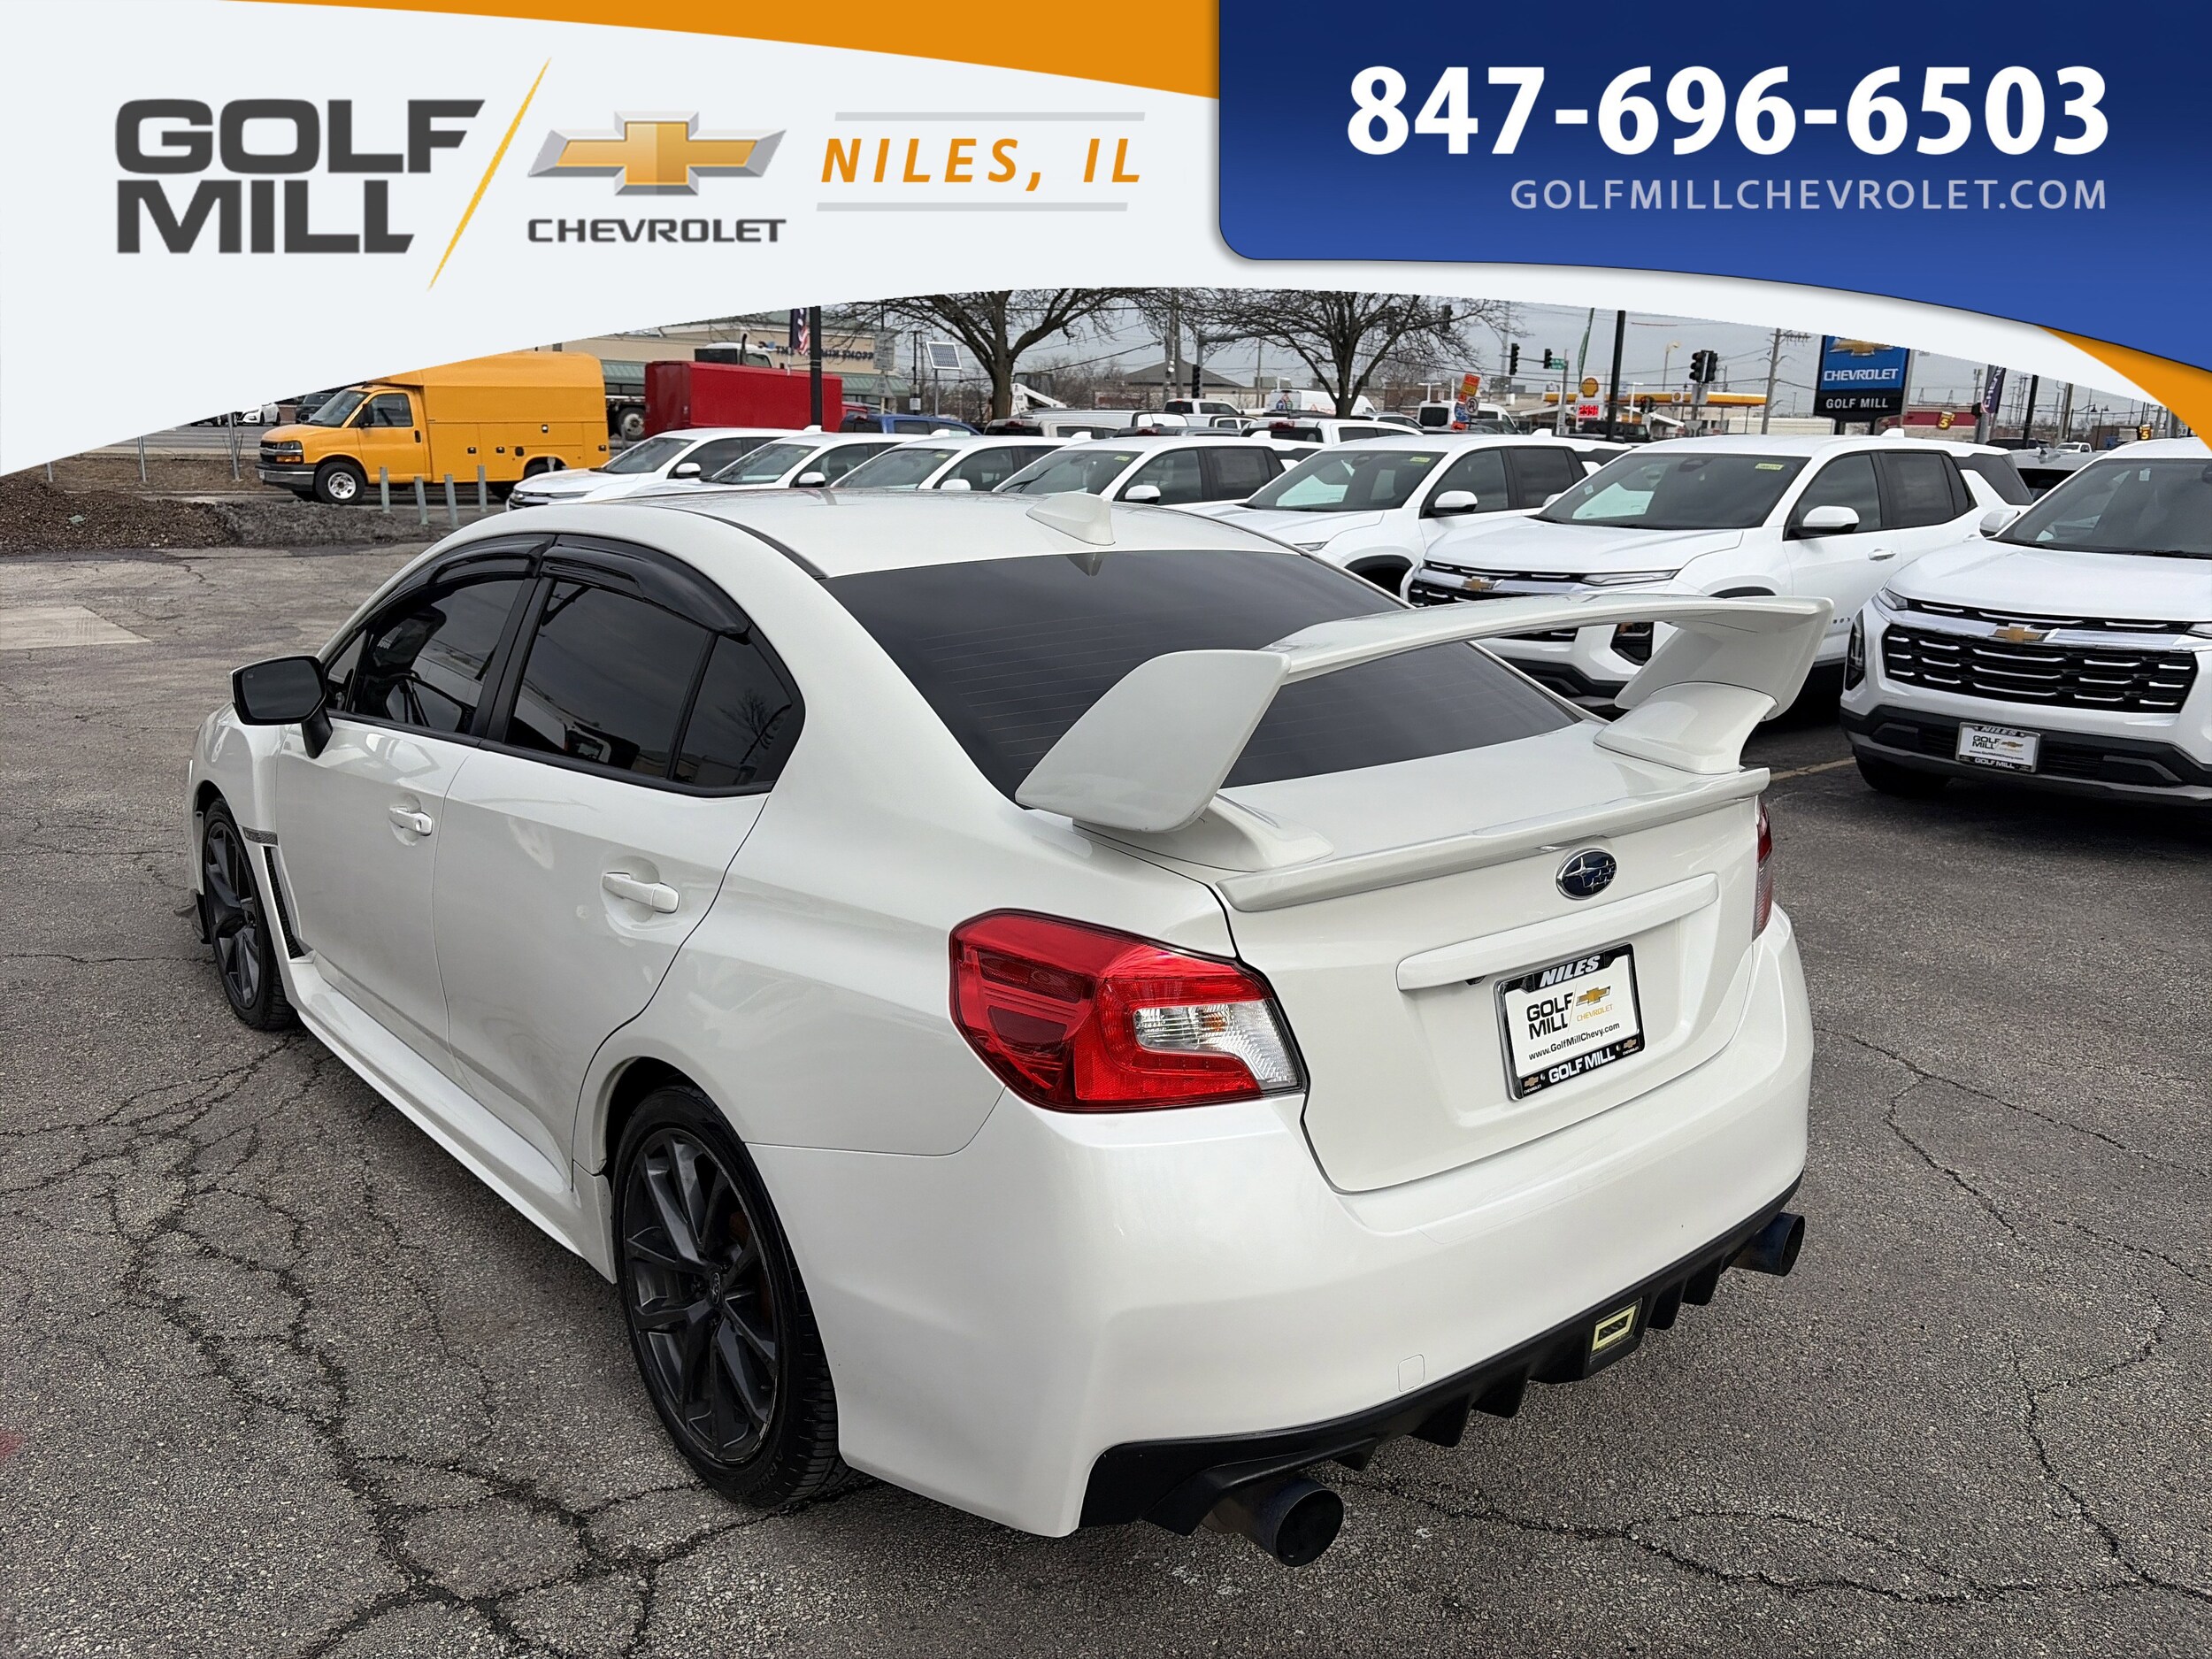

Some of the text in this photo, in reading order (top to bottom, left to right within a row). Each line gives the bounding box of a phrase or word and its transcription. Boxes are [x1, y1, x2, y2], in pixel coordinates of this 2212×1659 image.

[1824, 368, 1900, 381] CHEVROLET
[1825, 397, 1889, 409] GOLF MILL
[1973, 735, 2001, 744] GOLF
[1981, 726, 2018, 736] NILES
[1995, 761, 2016, 770] MILL
[1540, 956, 1601, 988] NILES
[1526, 992, 1574, 1022] GOLF
[1577, 1003, 1614, 1022] CHEVROLET
[1528, 1013, 1569, 1041] MILL
[1528, 1022, 1620, 1061] www.GolfMillChevy.com
[1548, 1048, 1616, 1084] GOLF MILL
